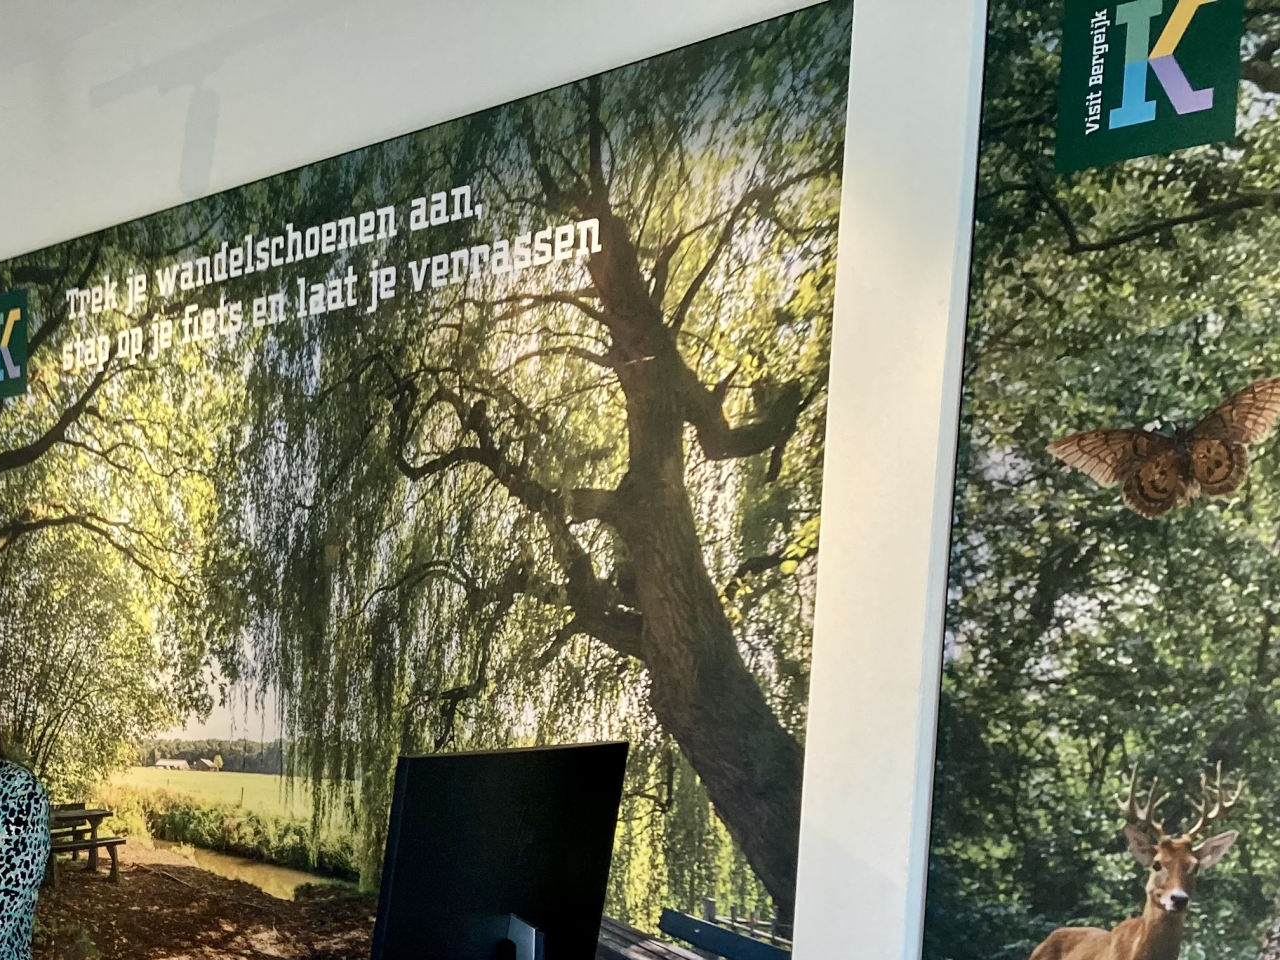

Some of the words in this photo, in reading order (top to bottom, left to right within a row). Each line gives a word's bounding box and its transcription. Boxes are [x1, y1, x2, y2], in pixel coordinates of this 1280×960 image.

[1088, 8, 1110, 85] Bergeijk
[1085, 90, 1102, 136] Visit
[62, 334, 111, 373] stap
[118, 326, 143, 365] op
[149, 313, 173, 361] je
[182, 297, 243, 344] fiets
[253, 291, 286, 328] en
[297, 265, 358, 318] laat
[367, 258, 397, 313] je
[408, 218, 602, 292] verrassen
[66, 274, 118, 320] Trek
[125, 269, 147, 315] je
[156, 205, 397, 297] wandelschoenen
[410, 185, 483, 231] aan,
